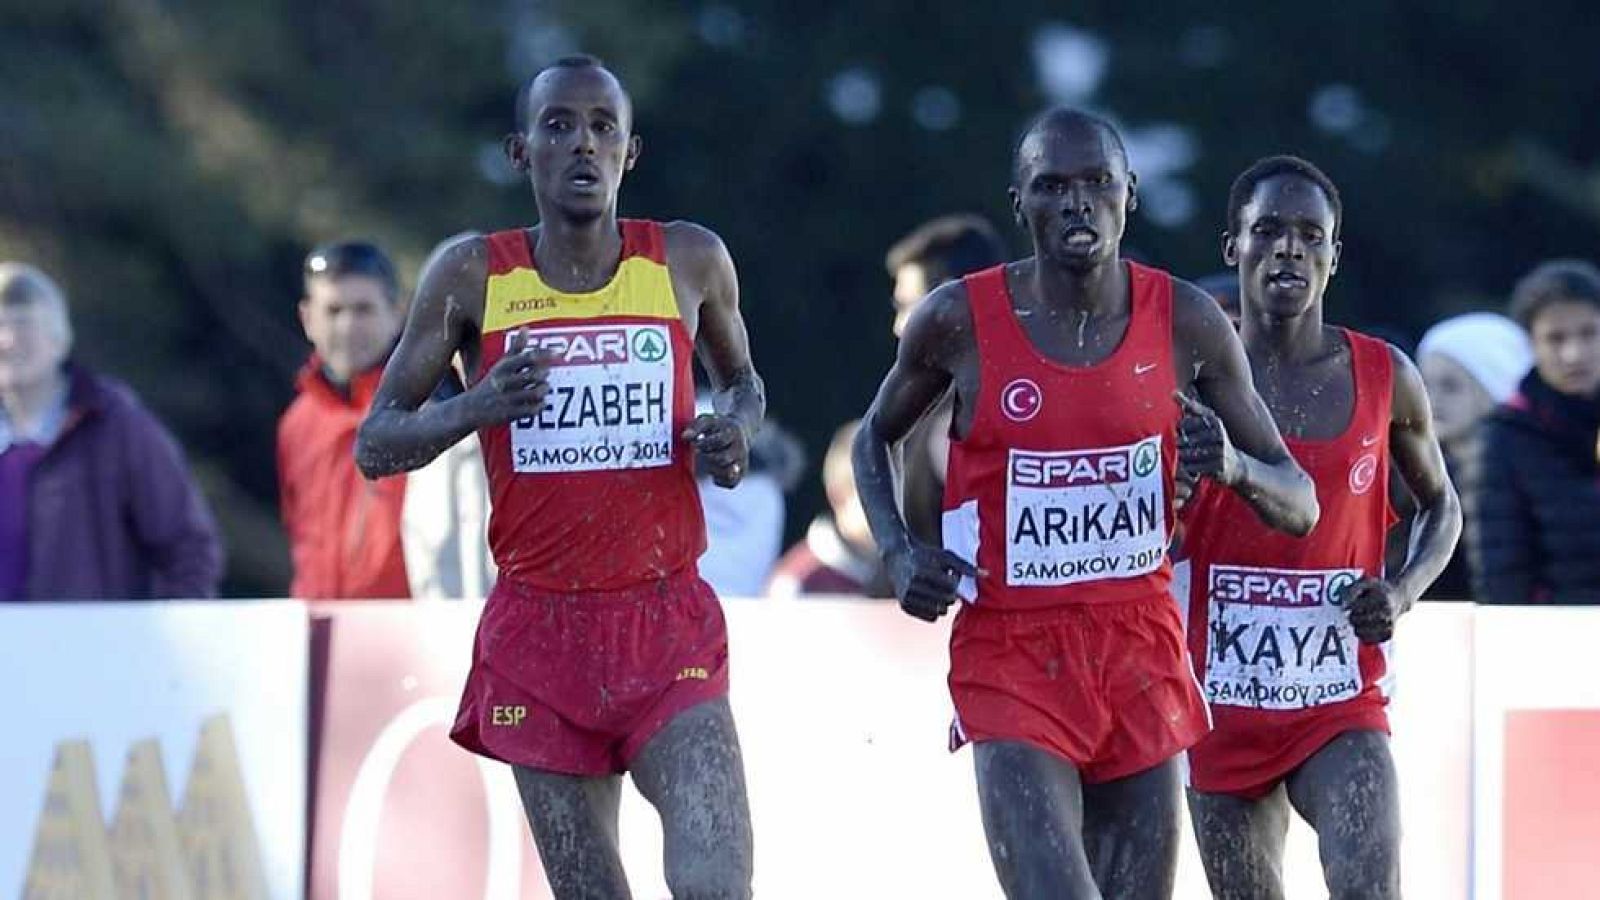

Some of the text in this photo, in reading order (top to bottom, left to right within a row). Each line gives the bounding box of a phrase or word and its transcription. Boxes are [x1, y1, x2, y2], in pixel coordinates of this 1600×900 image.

[524, 333, 627, 362] PAR
[516, 442, 670, 466] SAMOKOV 2014
[1014, 455, 1128, 485] SPAR
[1013, 548, 1163, 579] SAMOKOV 2014
[1214, 573, 1323, 603] SPAR
[1211, 622, 1348, 668] KAYA
[1207, 679, 1358, 703] SAMOKOV 2014
[492, 705, 527, 726] ESP
